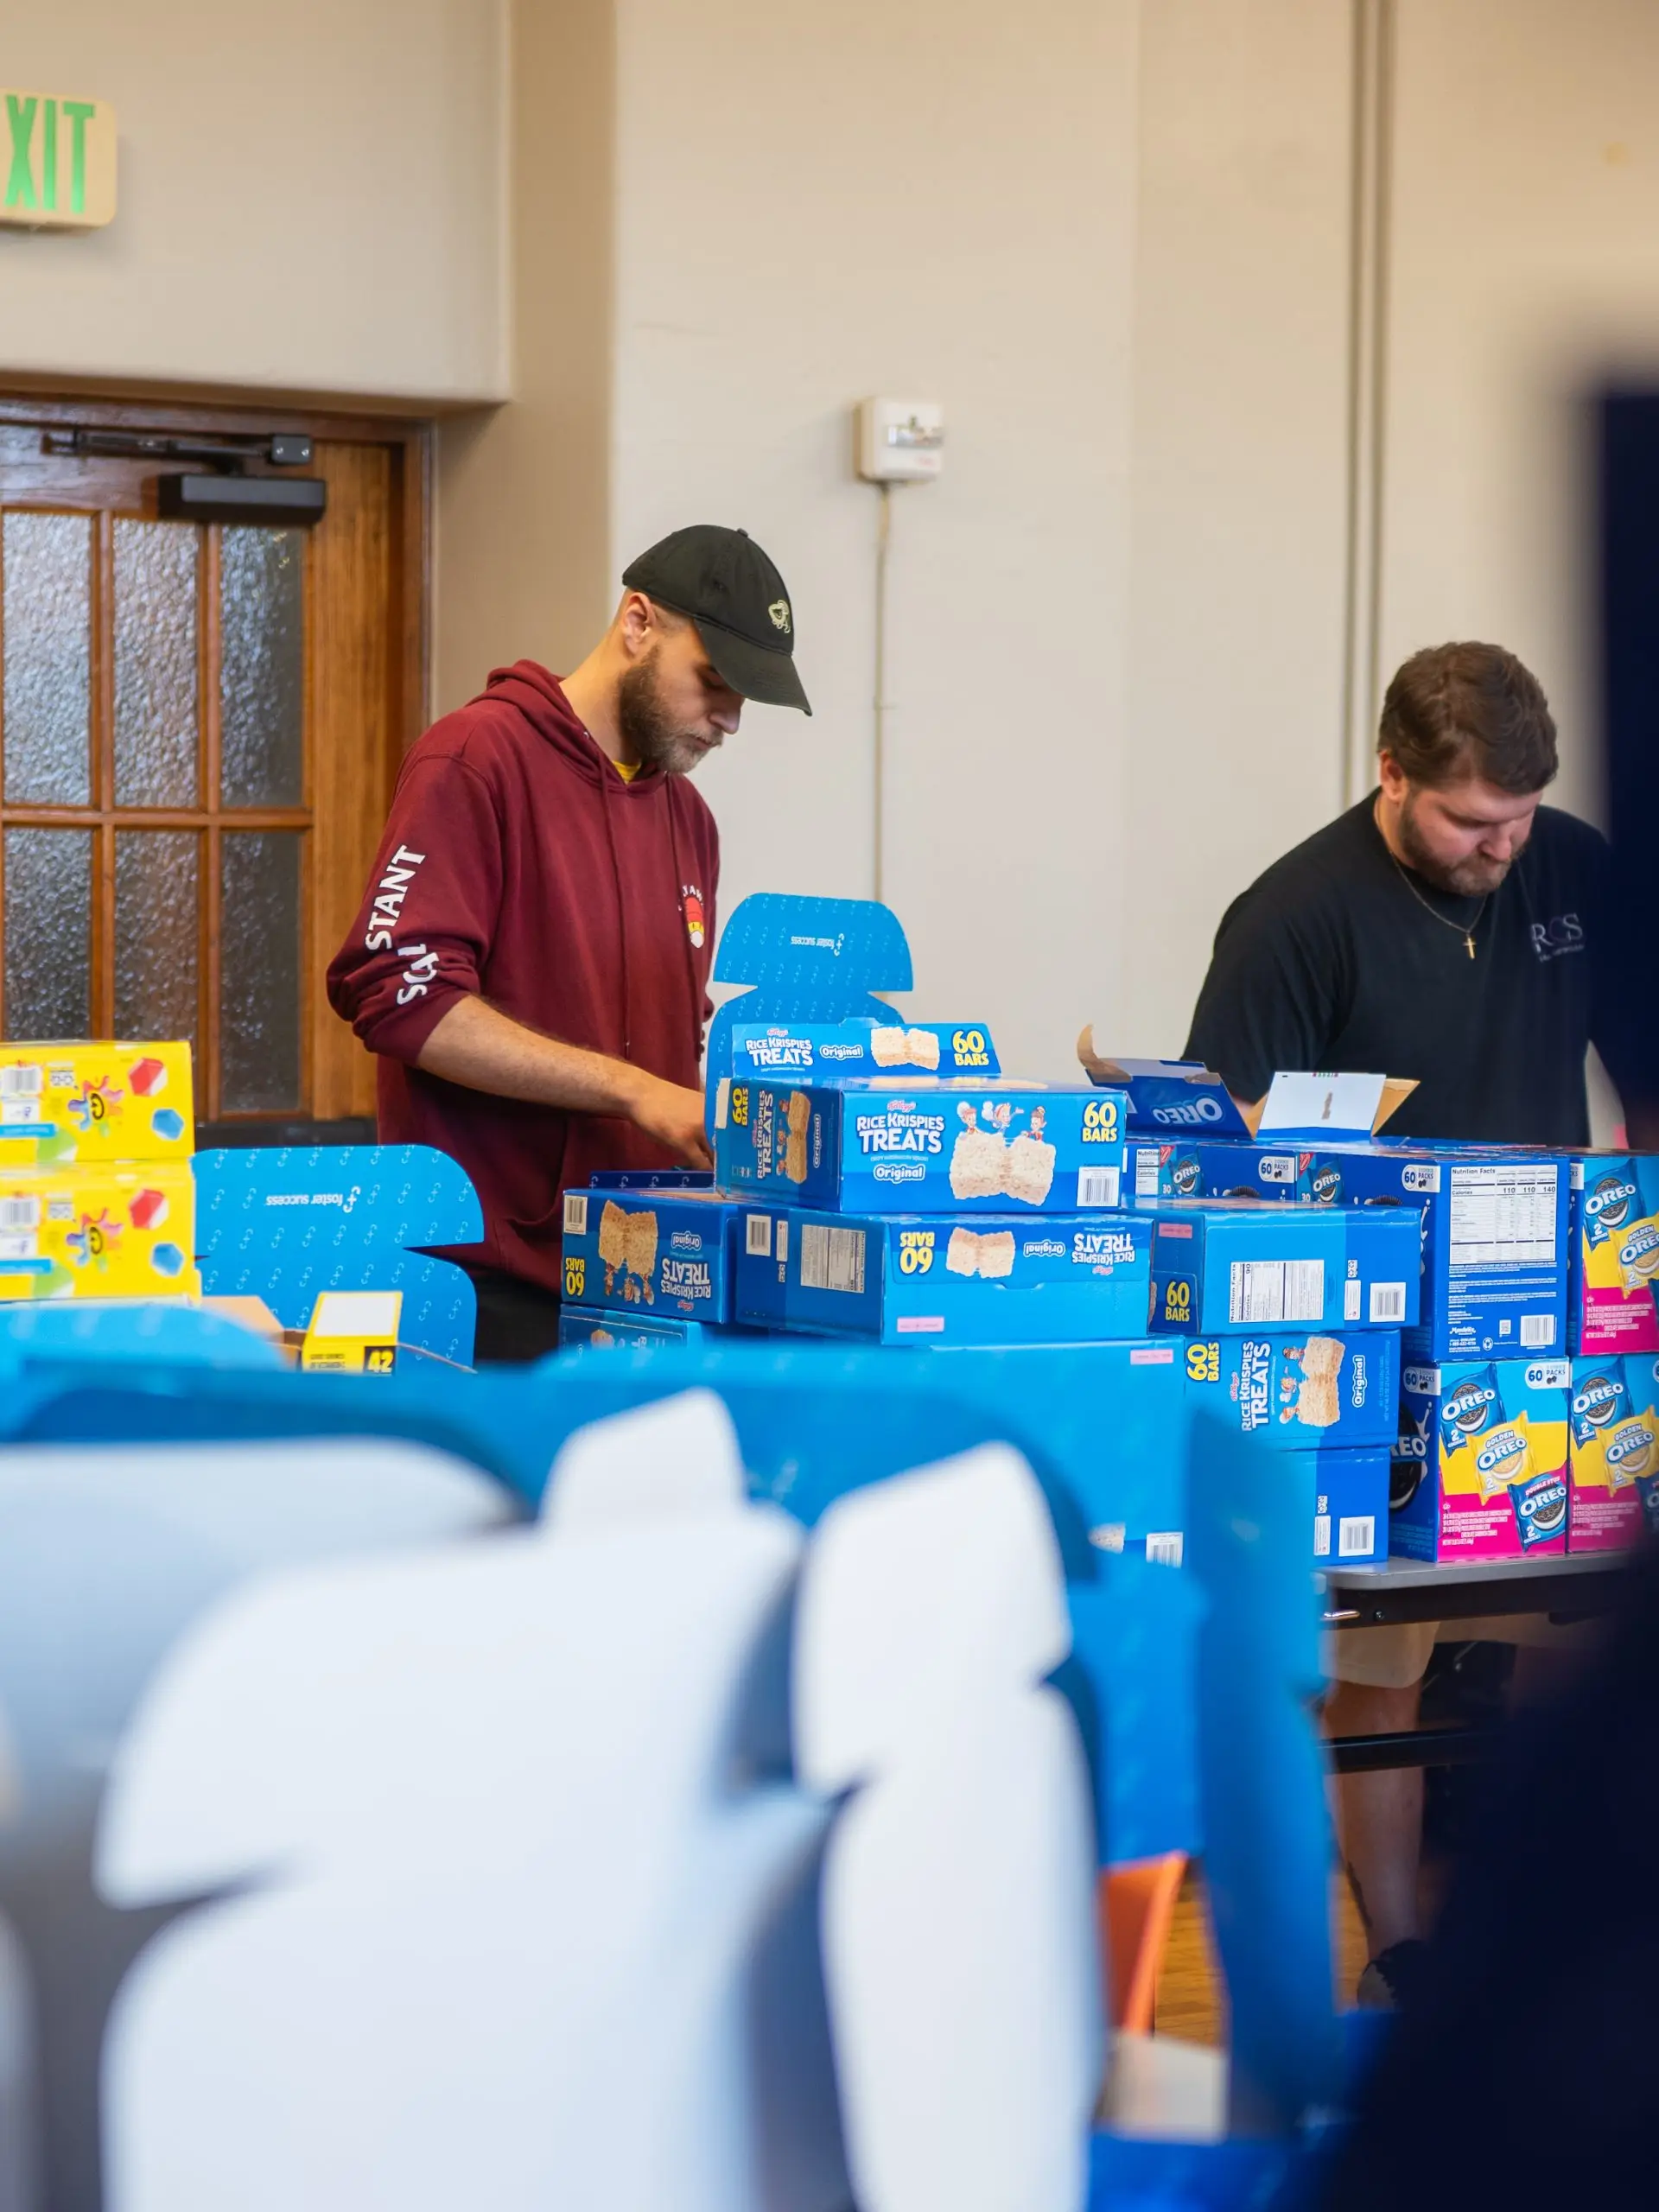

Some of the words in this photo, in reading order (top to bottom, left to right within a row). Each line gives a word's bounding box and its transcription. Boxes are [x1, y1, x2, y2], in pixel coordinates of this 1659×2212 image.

[4, 94, 95, 213] XIT
[746, 1039, 768, 1051] RICE
[768, 1037, 813, 1051] KRISPIES
[952, 1030, 985, 1053] 60
[748, 1048, 814, 1066] TREATS
[822, 1046, 861, 1058] Original
[954, 1052, 989, 1066] BARS
[732, 1087, 743, 1124] 60
[1084, 1101, 1117, 1128] 60
[1152, 1097, 1223, 1124] OREO
[757, 1090, 766, 1148] KRISPIES
[856, 1116, 887, 1131] RICE
[887, 1112, 945, 1132] KRISPIES
[762, 1092, 774, 1174] TREATS
[858, 1128, 942, 1154] TREATS
[1082, 1127, 1118, 1141] BARS
[875, 1166, 924, 1181] Original
[1173, 1165, 1201, 1184] OREO
[1261, 1162, 1272, 1175] 60
[1404, 1171, 1416, 1184] 60
[1162, 1184, 1172, 1194] 30
[1313, 1173, 1340, 1192] OREO
[265, 1194, 309, 1205] success
[311, 1193, 343, 1206] foster
[1585, 1184, 1636, 1215] OREO
[1593, 1223, 1603, 1235] 2
[673, 1234, 700, 1248] Original
[899, 1231, 935, 1247] BARS
[1025, 1241, 1064, 1255] Original
[1073, 1232, 1135, 1253] TREATS
[565, 1257, 585, 1272] BARS
[899, 1247, 933, 1274] 60
[1071, 1250, 1114, 1266] KRISPIES
[1114, 1250, 1135, 1262] RICE
[661, 1258, 710, 1286] TREATS
[566, 1271, 584, 1296] 60
[660, 1279, 694, 1300] KRISPIES
[694, 1284, 712, 1299] RICE
[1166, 1281, 1190, 1307] 60
[1165, 1306, 1190, 1322] BARS
[366, 1349, 395, 1373] 42
[1187, 1344, 1208, 1381] 60
[1207, 1342, 1220, 1382] BARS
[1239, 1341, 1254, 1400] KRISPIES
[1354, 1357, 1365, 1404] Original
[1405, 1372, 1417, 1386] 60
[1528, 1370, 1543, 1382] 60
[1250, 1343, 1271, 1429] TREATS
[1442, 1390, 1495, 1420] OREO
[1573, 1383, 1624, 1413] OREO
[1241, 1402, 1252, 1431] RICE
[1451, 1430, 1459, 1442] 2
[1580, 1422, 1589, 1433] 2
[1614, 1423, 1643, 1441] GOLDEN
[1390, 1435, 1426, 1458] EO
[1485, 1430, 1515, 1449] GOLDEN
[1607, 1433, 1654, 1463] OREO
[1478, 1439, 1526, 1470] OREO
[1485, 1478, 1493, 1489] 2
[1520, 1487, 1567, 1516] OREO
[1527, 1526, 1535, 1538] 2
